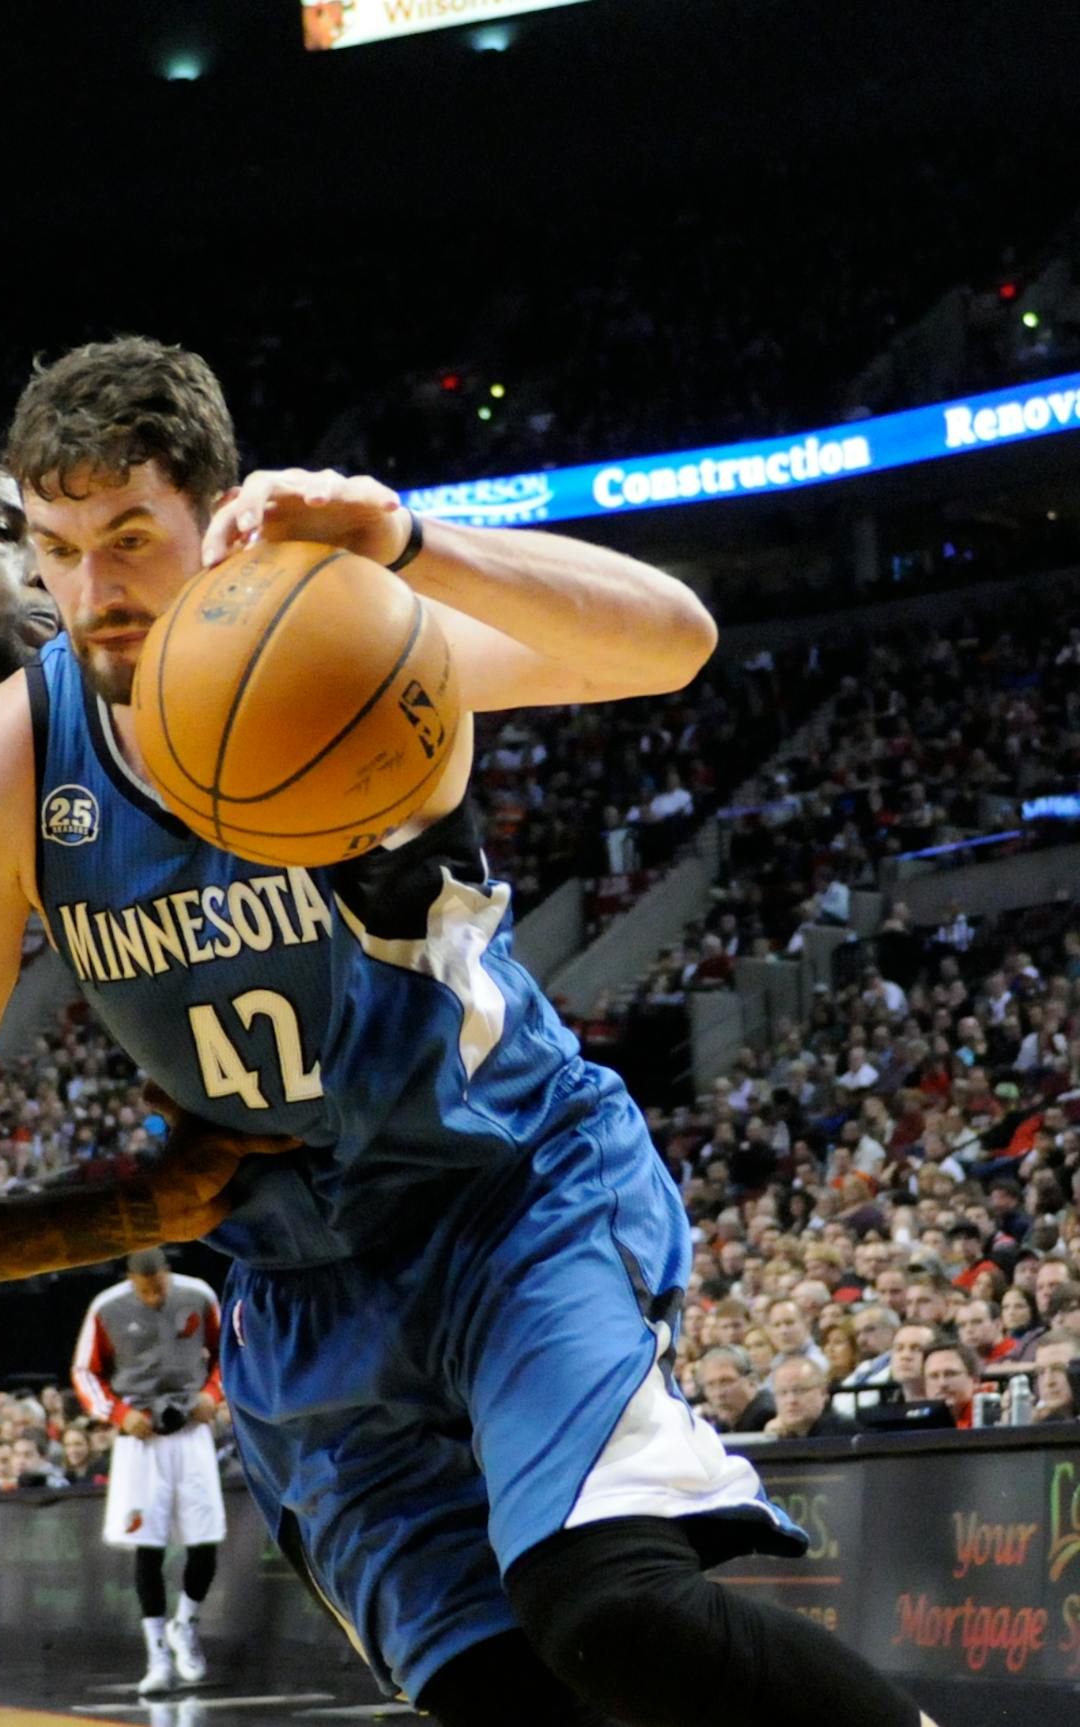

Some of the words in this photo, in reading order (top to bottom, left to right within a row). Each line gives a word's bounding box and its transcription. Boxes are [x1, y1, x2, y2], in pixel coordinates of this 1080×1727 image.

[944, 388, 1080, 448] Renov
[593, 436, 870, 508] Construction
[49, 796, 93, 828] 25
[59, 866, 334, 983] MINNESOTA
[188, 988, 325, 1111] 42
[953, 1511, 1039, 1579] Your
[891, 1593, 1049, 1672] Mortgage
